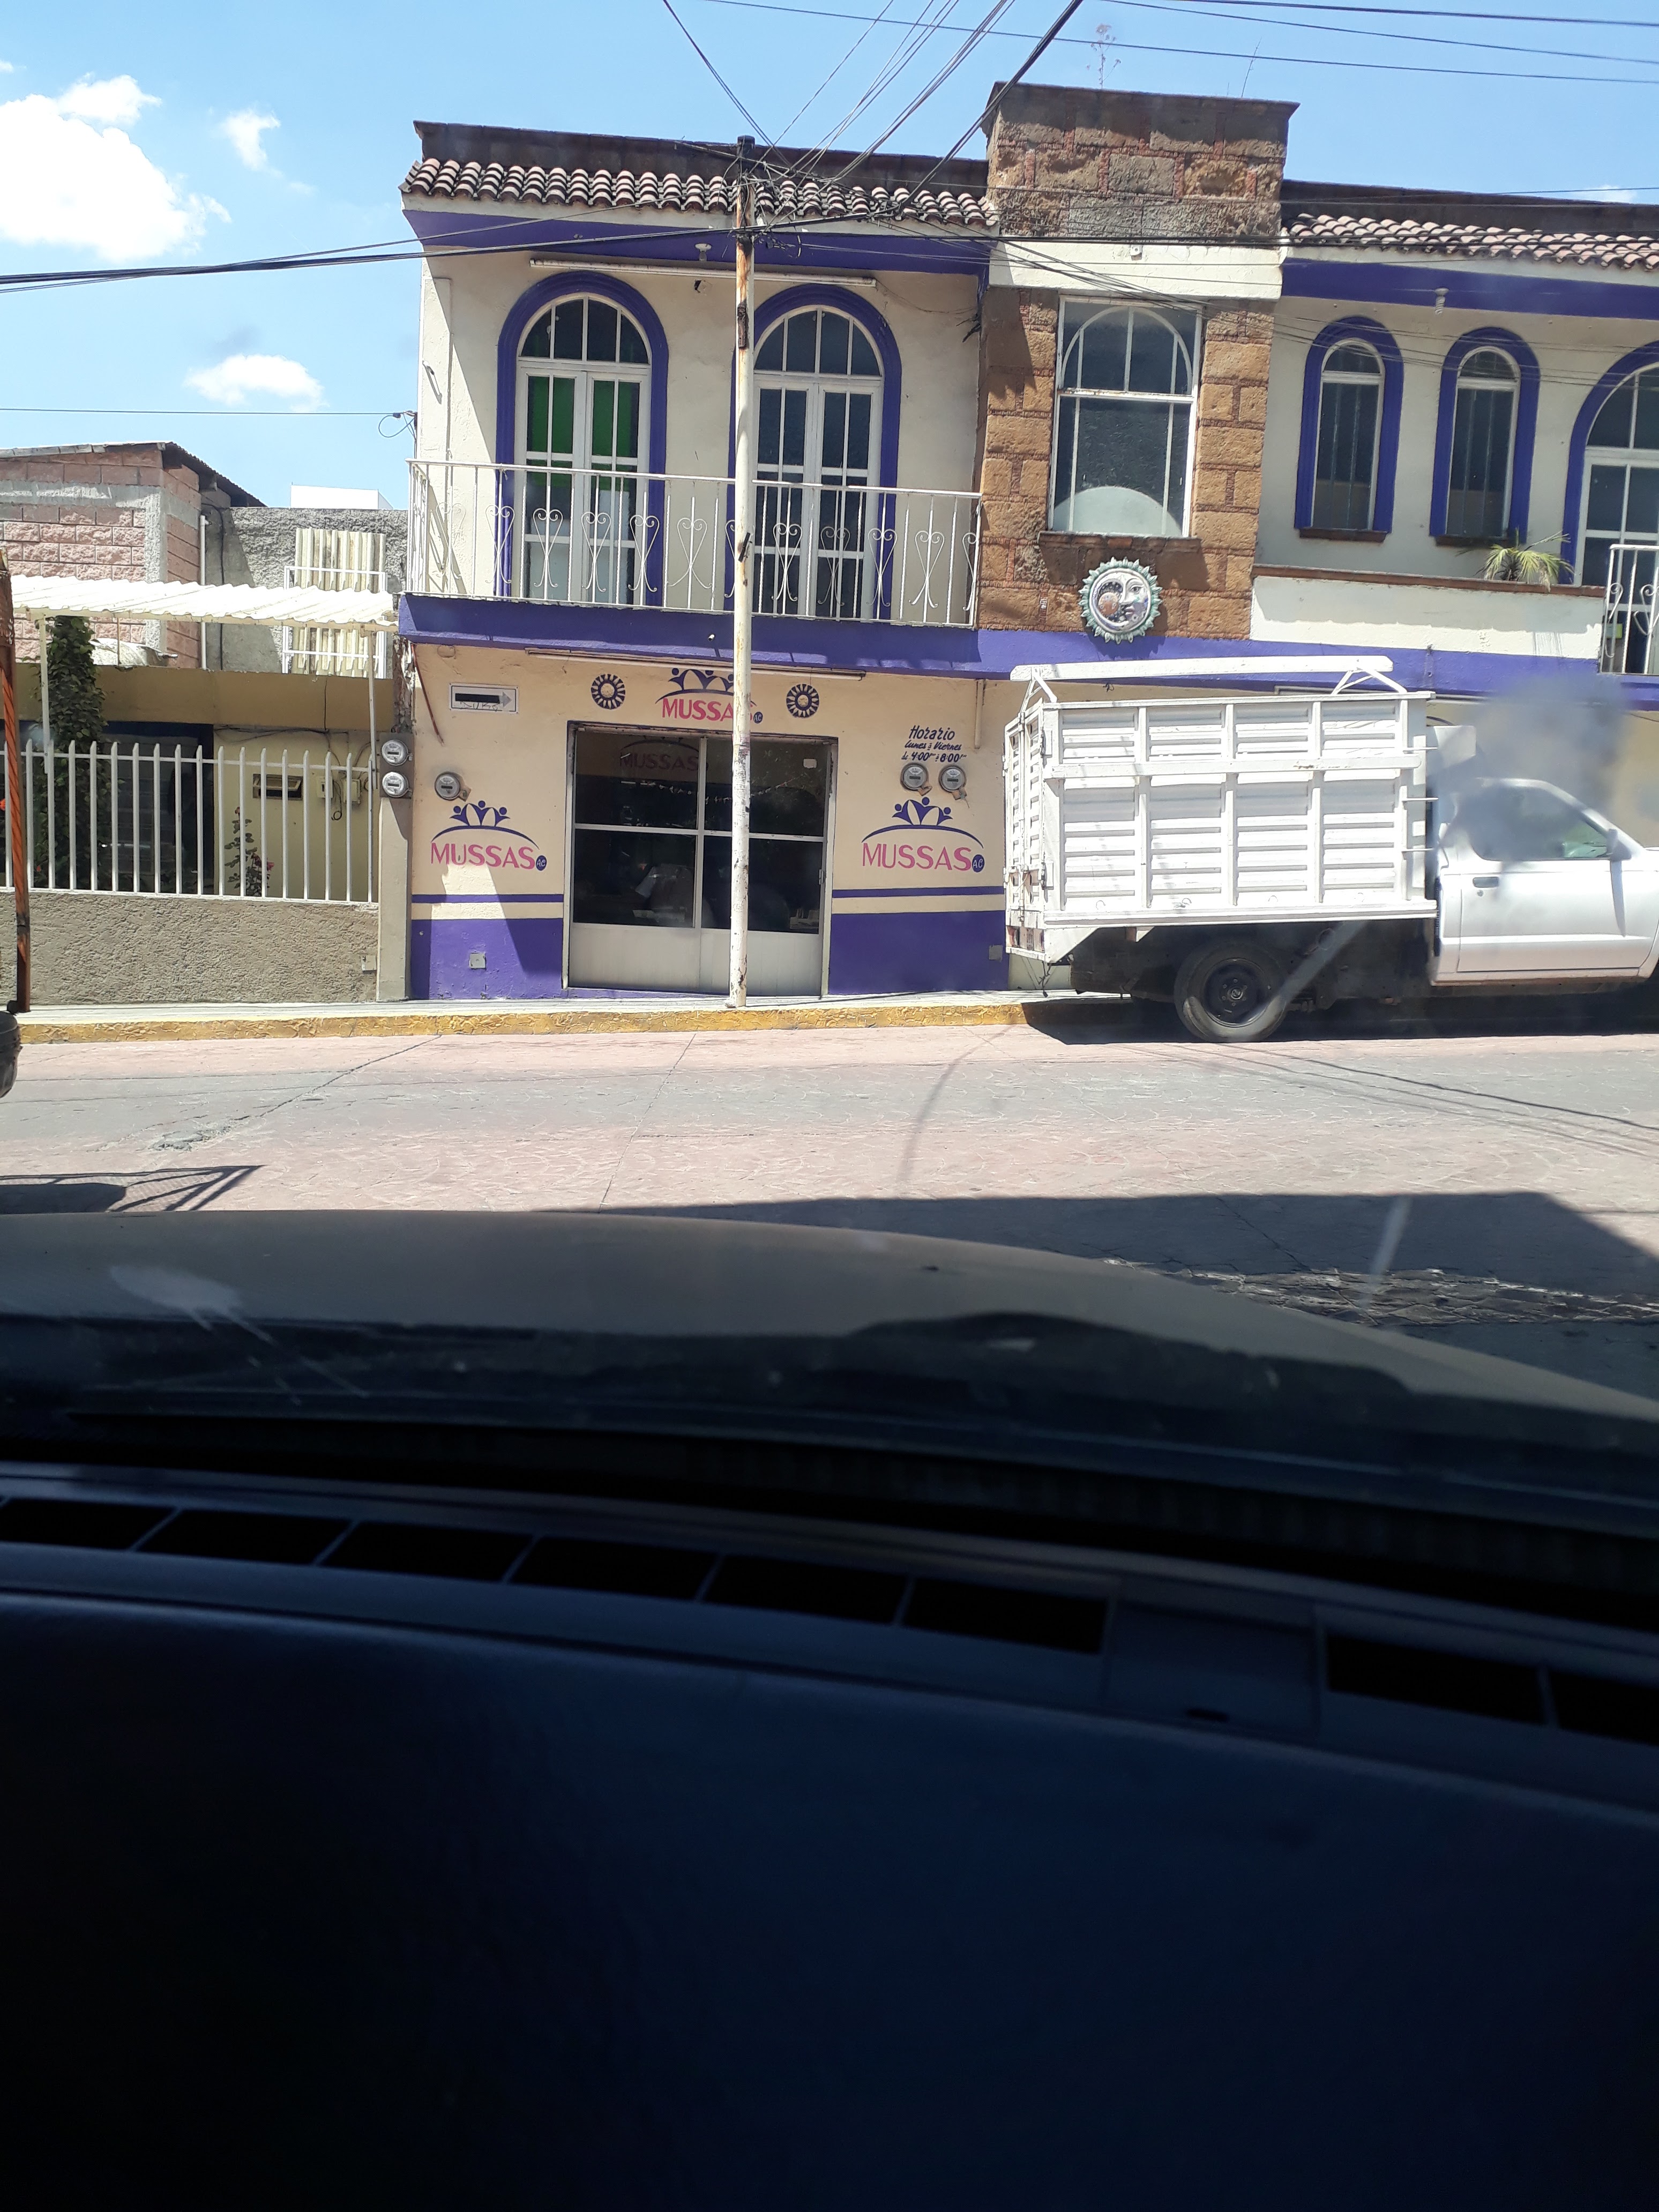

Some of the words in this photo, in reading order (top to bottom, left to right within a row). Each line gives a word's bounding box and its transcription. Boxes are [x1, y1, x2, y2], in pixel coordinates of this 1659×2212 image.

[662, 698, 753, 722] MUSSA
[908, 725, 955, 740] Horario
[620, 752, 699, 771] MUSSAS
[431, 842, 535, 870] MUSSAS
[862, 842, 972, 871] MUSSAS
